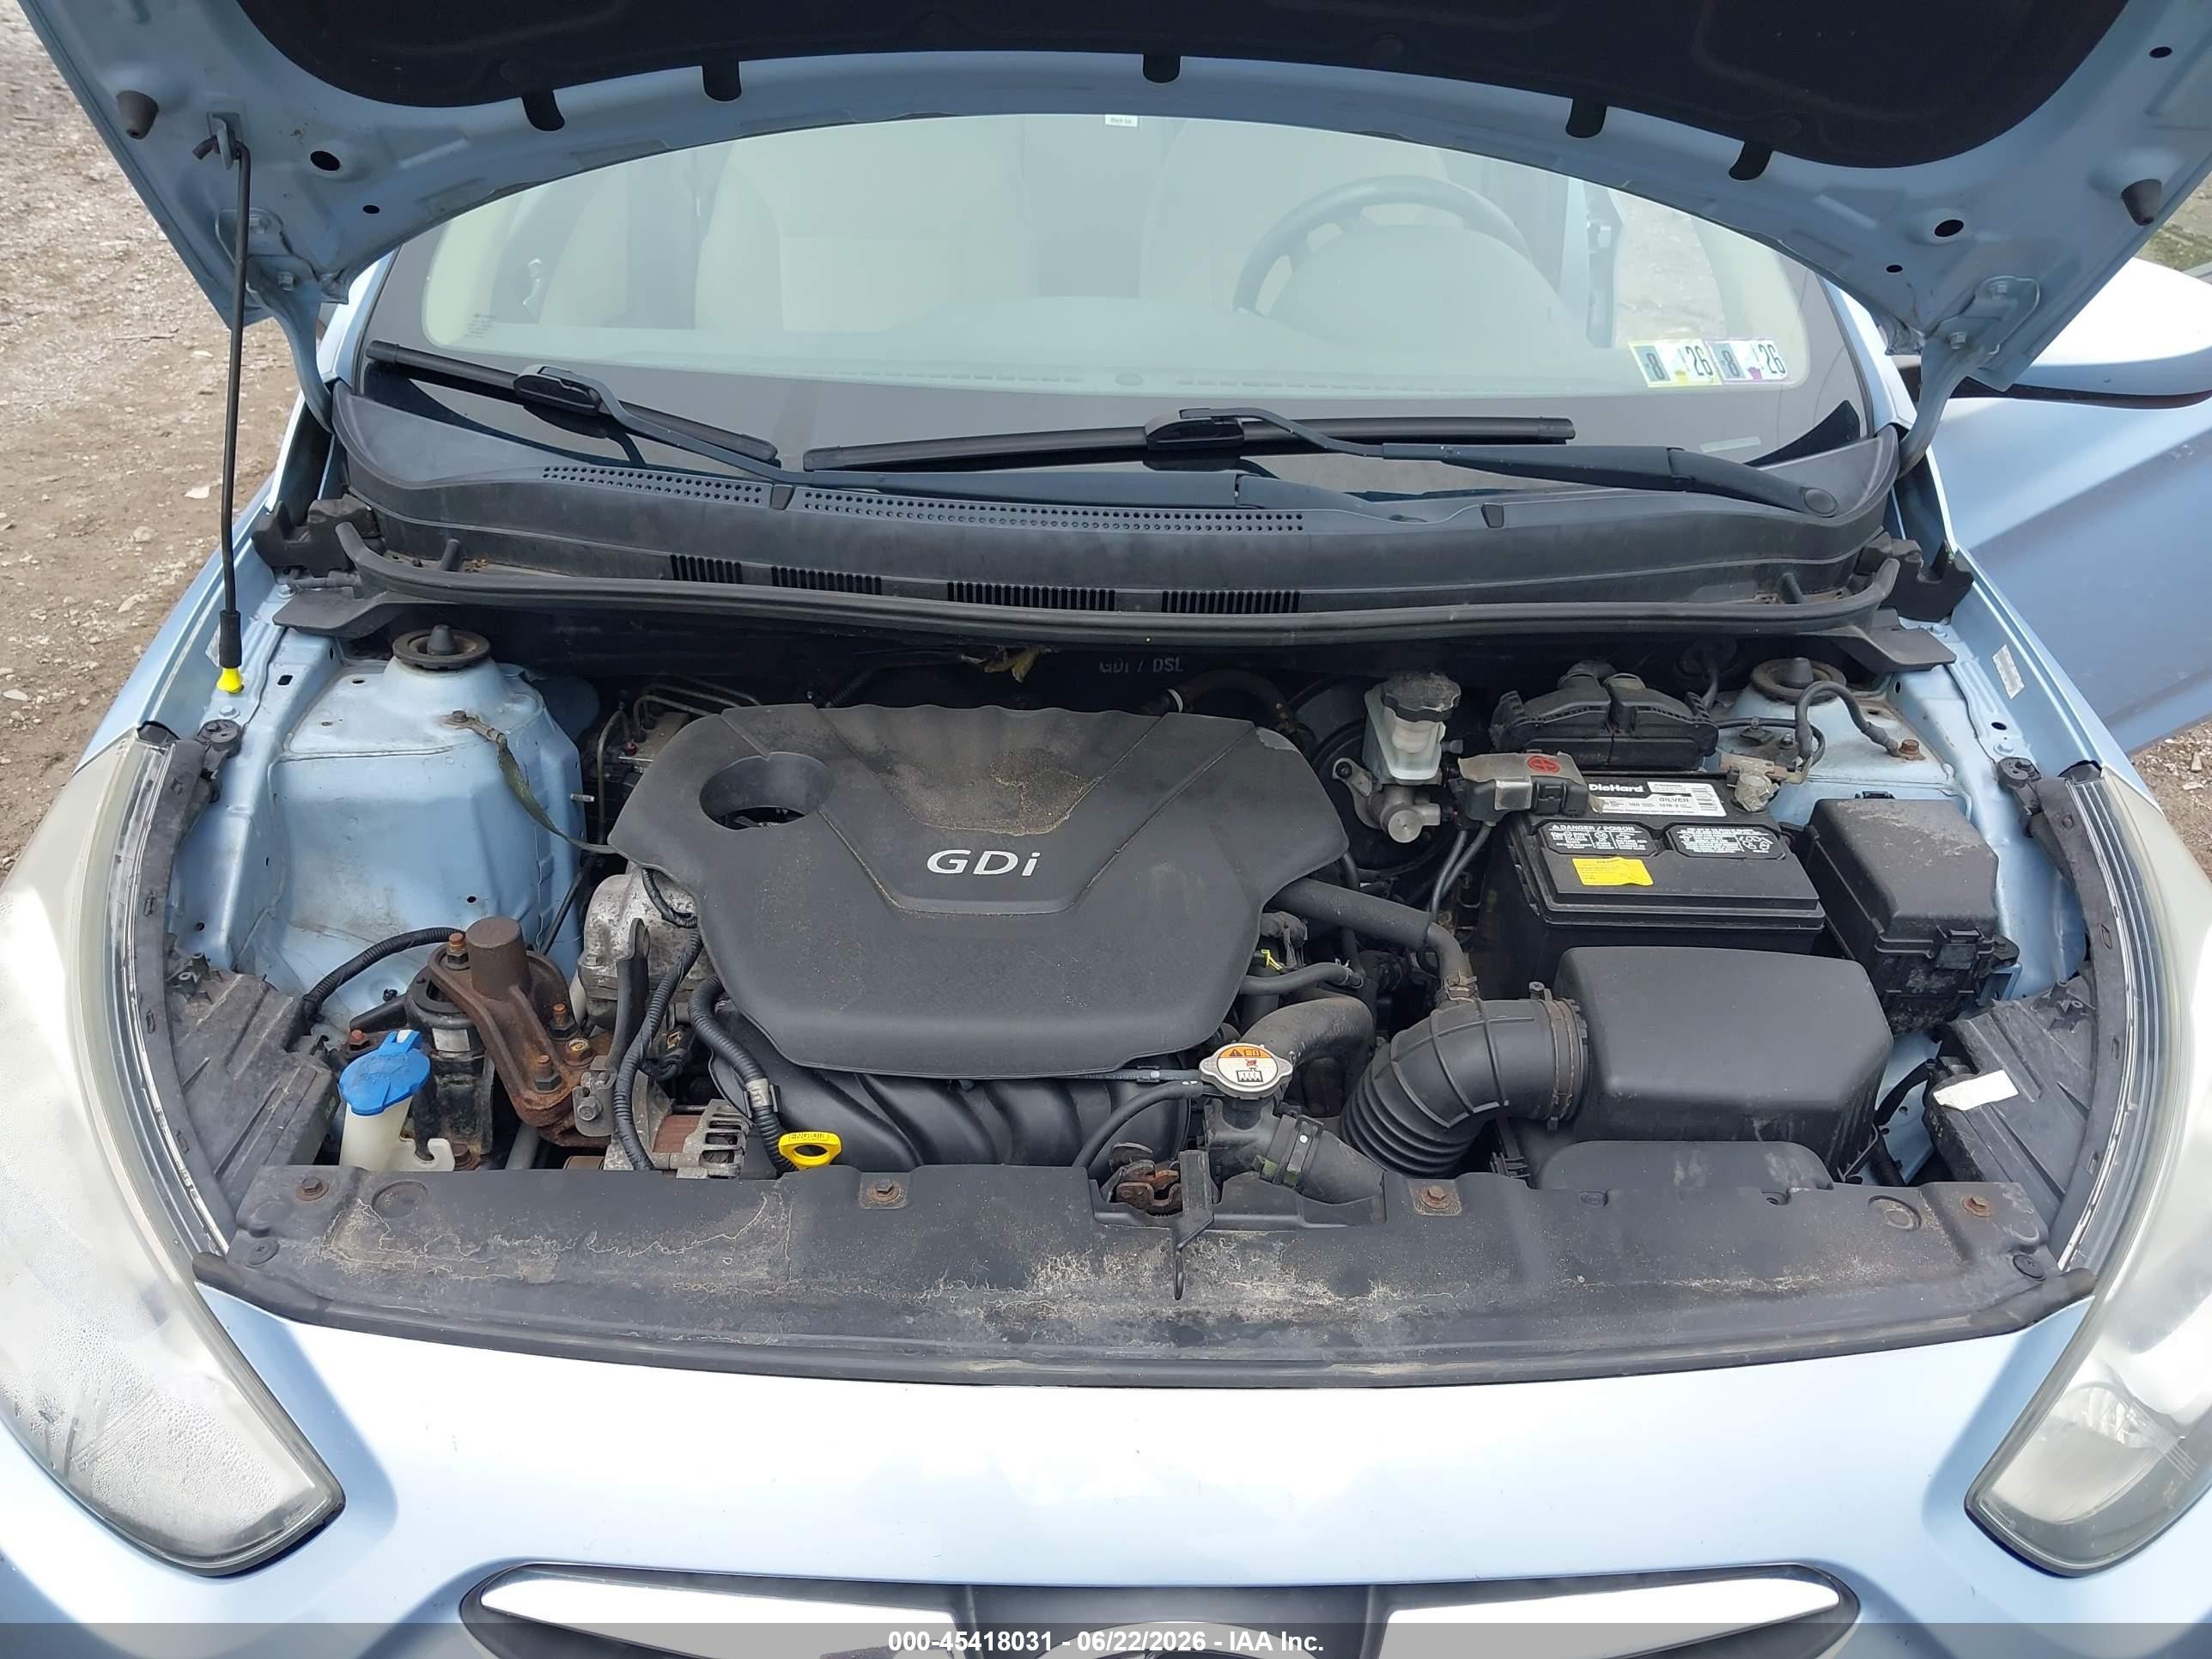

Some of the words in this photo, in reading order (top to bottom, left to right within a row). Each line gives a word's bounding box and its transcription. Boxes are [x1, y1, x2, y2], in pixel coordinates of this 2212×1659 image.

[1686, 345, 1713, 376] 26
[1758, 343, 1786, 374] 26
[1152, 657, 1183, 672] DSL
[927, 849, 1041, 877] GDi
